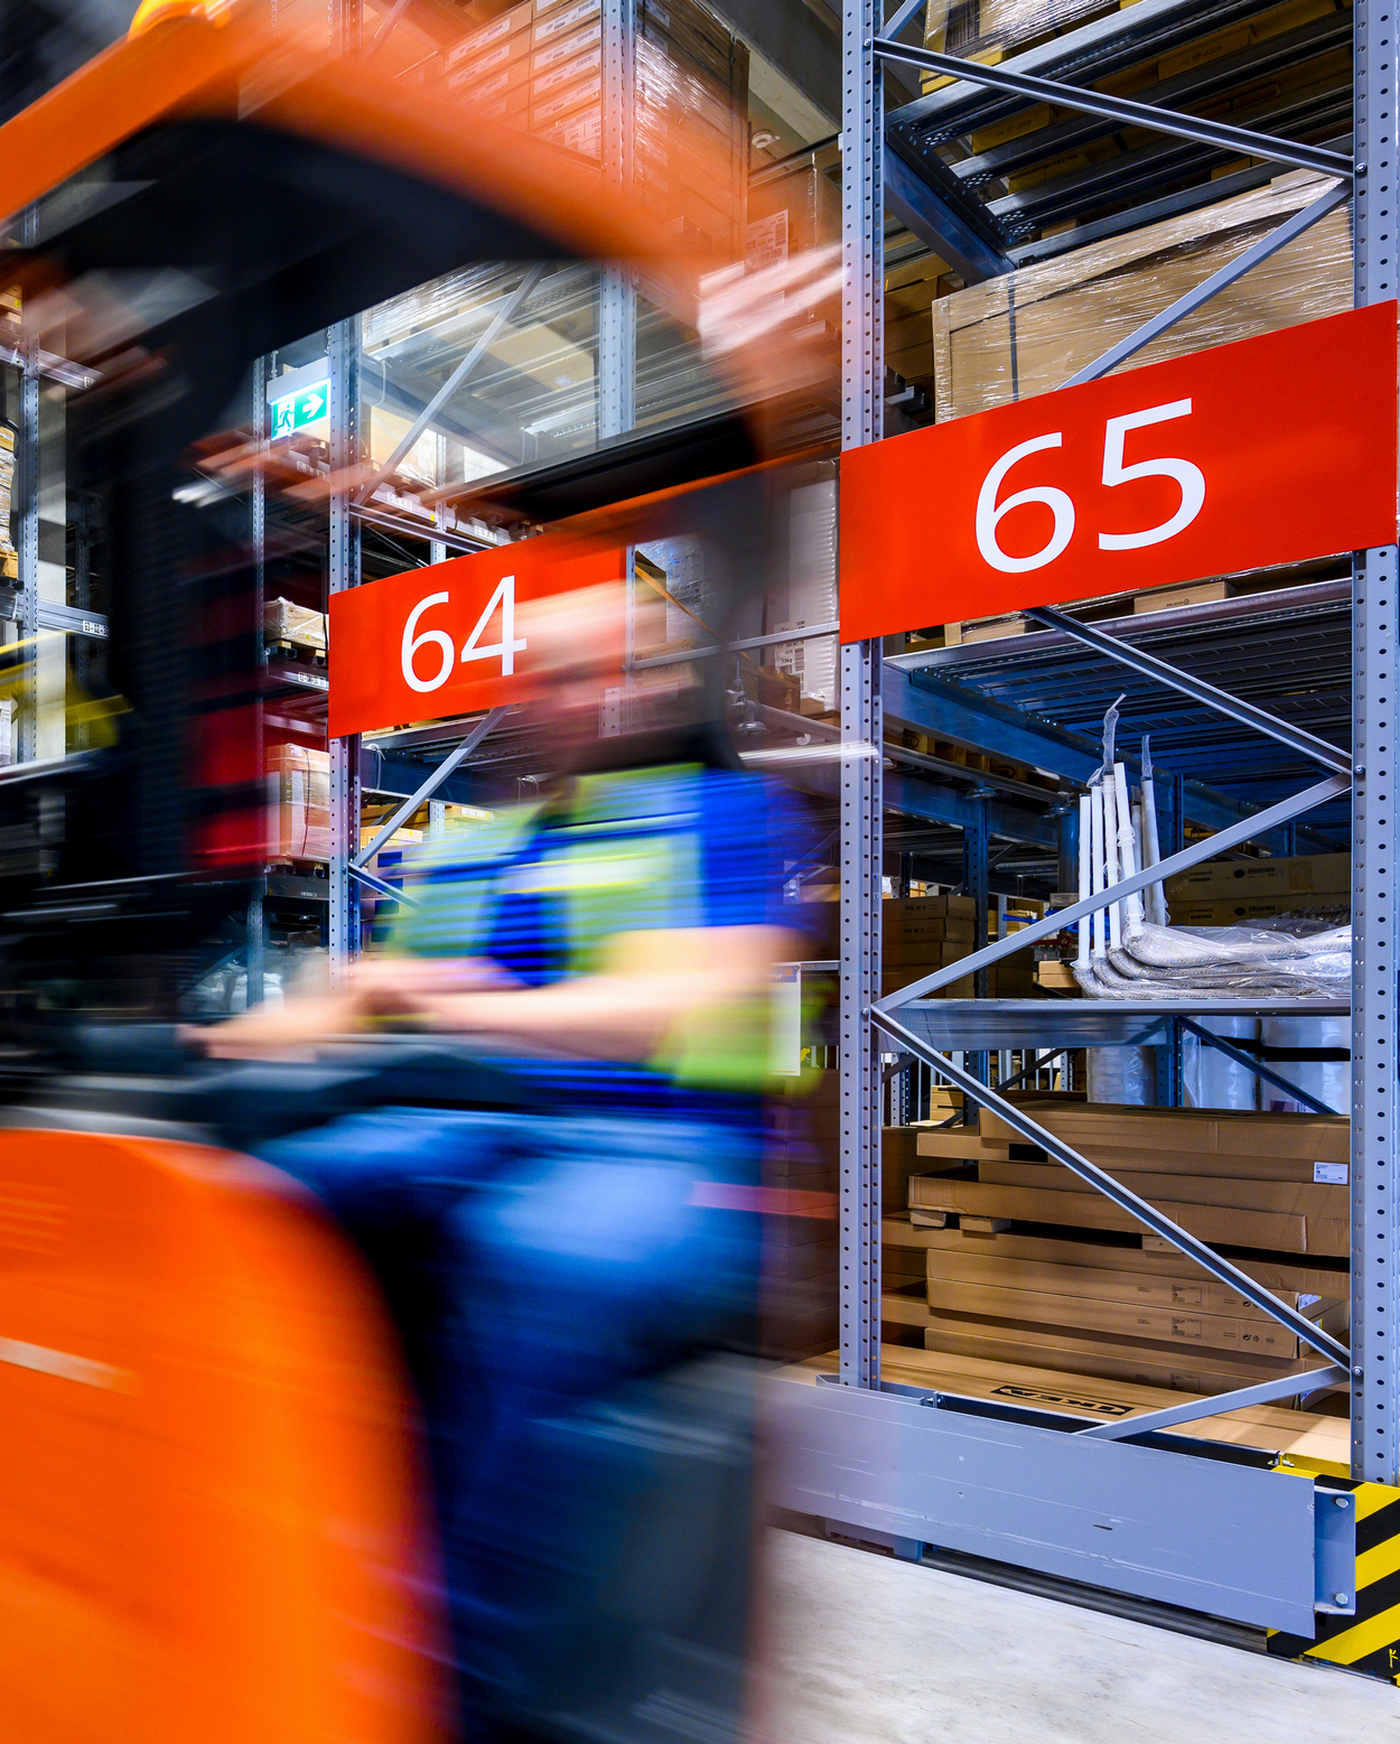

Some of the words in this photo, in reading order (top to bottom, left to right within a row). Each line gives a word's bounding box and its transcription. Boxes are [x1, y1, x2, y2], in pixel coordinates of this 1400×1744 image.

[975, 397, 1206, 574] 65
[401, 575, 527, 693] 64
[997, 1387, 1128, 1414] IKEA
